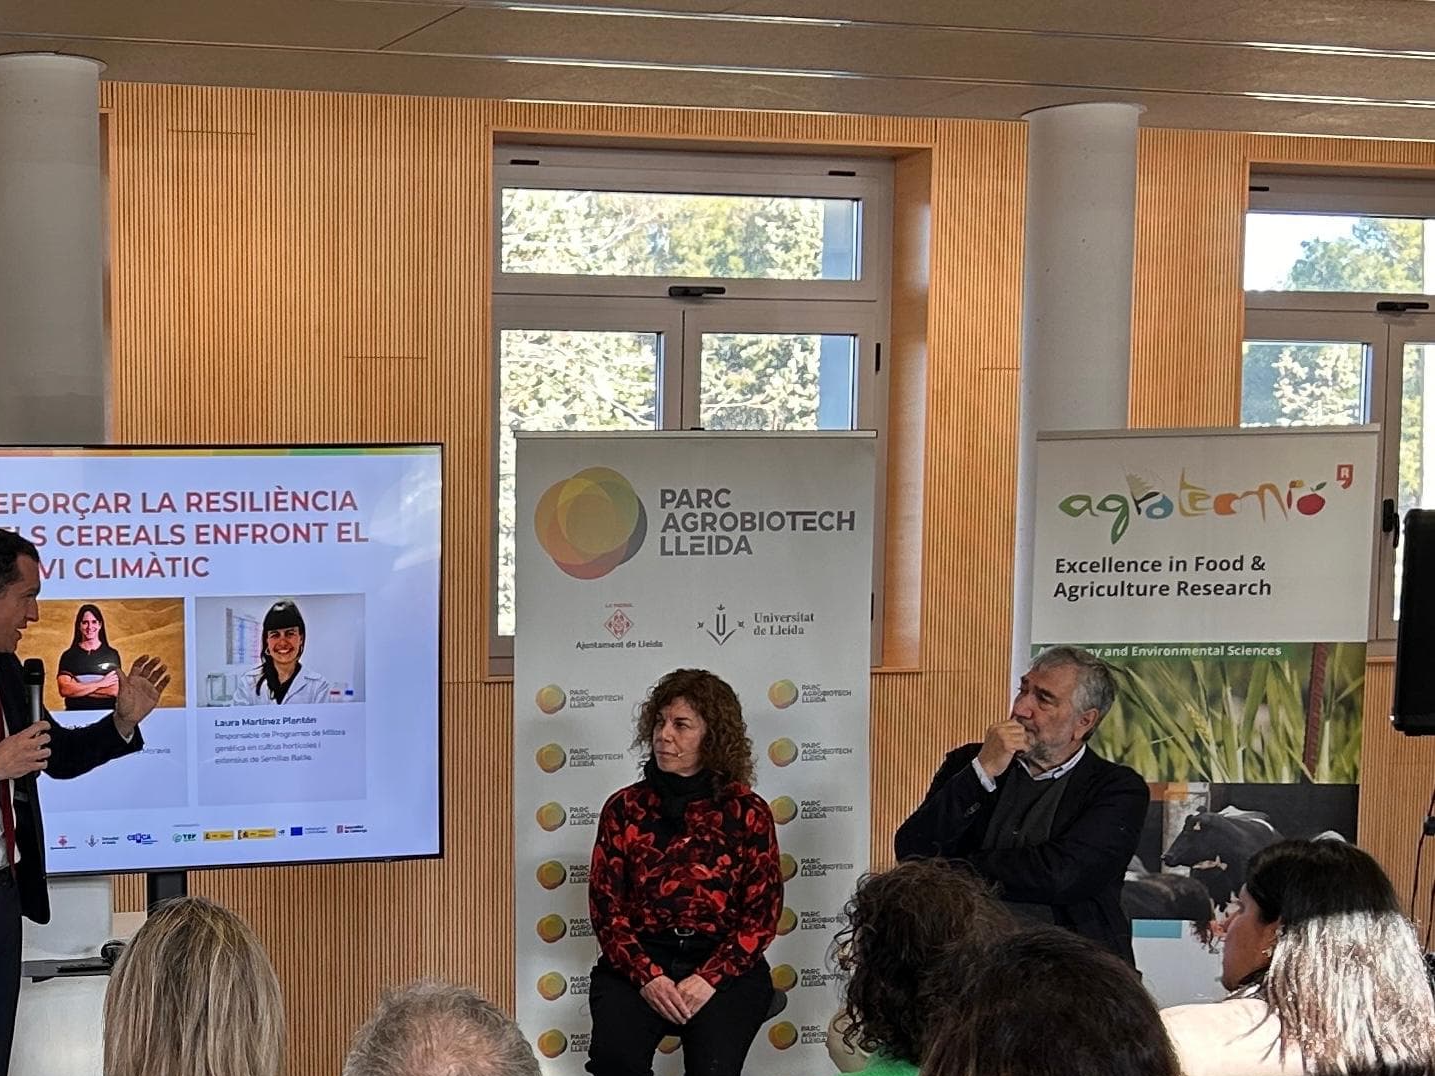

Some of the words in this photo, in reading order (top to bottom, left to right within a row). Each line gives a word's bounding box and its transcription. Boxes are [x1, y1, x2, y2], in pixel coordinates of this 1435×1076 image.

[141, 492, 177, 513] LA
[185, 485, 358, 513] RESILIÈNCIA
[660, 488, 732, 510] PARC
[660, 511, 855, 533] AGROBIOTECH
[56, 523, 186, 547] CEREALS
[195, 522, 328, 545] ENFRONT
[337, 522, 369, 543] EL
[660, 535, 753, 557] LLEIDA
[75, 551, 209, 579] CLIMÀTIC
[1055, 556, 1162, 575] Excellence
[1169, 556, 1188, 572] in
[1194, 555, 1244, 572] Food
[1251, 555, 1266, 571] &
[1054, 580, 1170, 602] Agriculture
[1177, 578, 1271, 597] Research
[754, 612, 814, 623] Universitat
[753, 625, 767, 636] de
[769, 625, 804, 635] Lleida
[576, 640, 624, 650] Ajuntament
[1104, 647, 1128, 657] and
[1131, 645, 1224, 657] Environmental
[1227, 645, 1282, 656] Sciences
